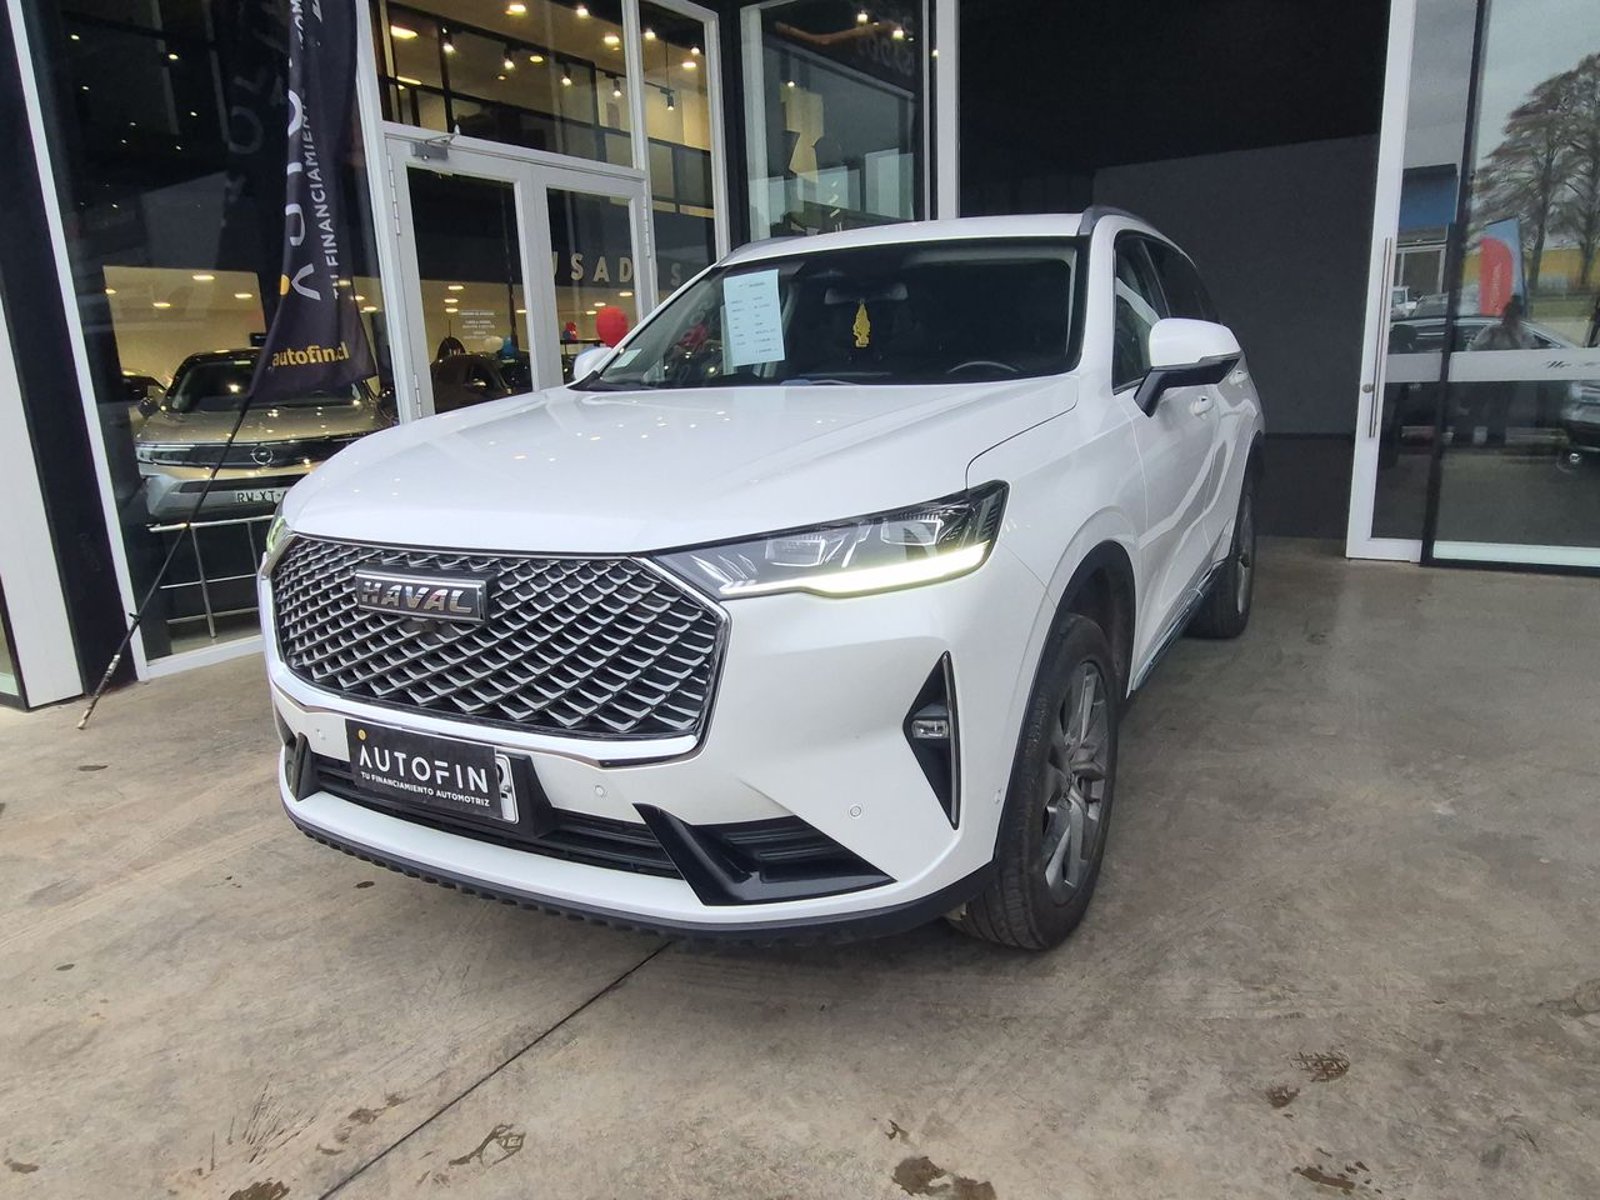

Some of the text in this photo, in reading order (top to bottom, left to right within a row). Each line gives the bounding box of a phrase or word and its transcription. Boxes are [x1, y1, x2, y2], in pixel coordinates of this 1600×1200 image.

[272, 341, 349, 367] autofin.cl
[361, 581, 472, 614] HAVAL
[359, 745, 489, 794] AUTOFIN
[361, 771, 491, 807] TU FINANCIAMIENTO AUTOMOTRIZ
